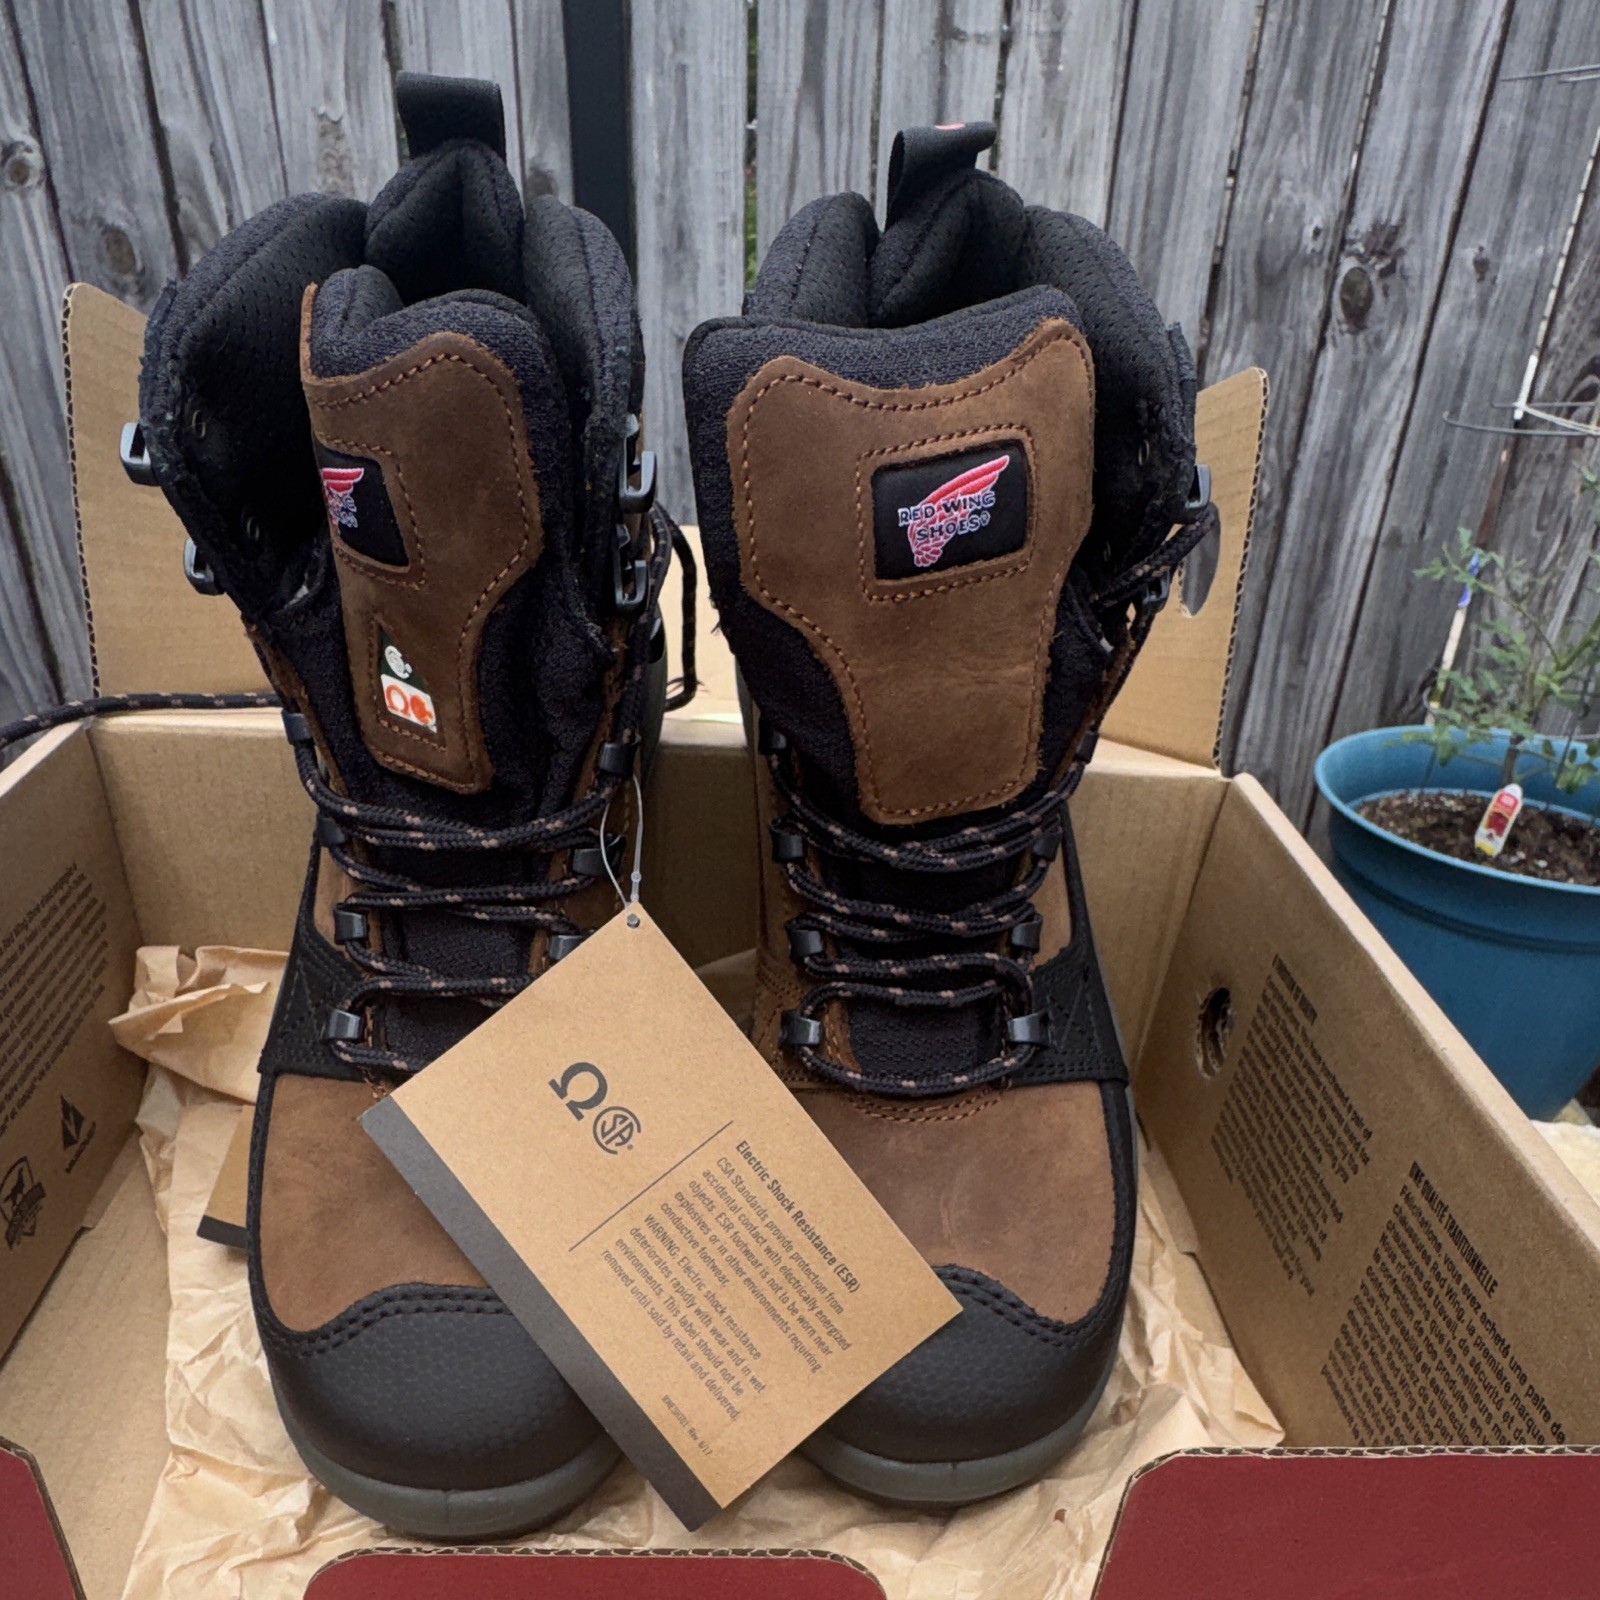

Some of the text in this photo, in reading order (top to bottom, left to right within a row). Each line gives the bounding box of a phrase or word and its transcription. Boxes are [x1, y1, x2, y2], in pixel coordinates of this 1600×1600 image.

[897, 490, 996, 528] RED WING
[641, 1213, 764, 1361] WARNING: Electric shock resistance
[657, 1200, 702, 1250] conductive
[670, 1189, 824, 1374] explosives or in other environments requiring
[699, 1167, 852, 1353] accidental contact with electrically energized
[713, 1212, 734, 1234] ESR
[727, 1230, 765, 1271] footwear
[757, 1266, 771, 1279] is
[764, 1275, 784, 1295] not
[777, 1290, 792, 1305] to
[785, 1300, 802, 1317] be
[794, 1313, 818, 1338] worn
[812, 1334, 834, 1357] near
[714, 1155, 846, 1315] CSA Standards provide protection from
[733, 1139, 862, 1295] Electric Shock Resistance (ESR)
[1408, 1159, 1499, 1299] UNE QUALITÉ TRADITIONNELLE
[598, 1248, 634, 1288] removed
[628, 1284, 652, 1310] until
[645, 1305, 667, 1329] sold
[659, 1323, 677, 1341] by
[669, 1335, 695, 1363] retail
[688, 1358, 710, 1381] and
[626, 1225, 767, 1394] deteriorates rapidly with wear and in wet
[660, 1295, 683, 1318] This
[676, 1313, 701, 1341] label
[693, 1336, 724, 1370] should
[717, 1365, 736, 1384] not
[729, 1380, 746, 1397] be
[1378, 1230, 1398, 1265] Nous
[1427, 1316, 1446, 1349] que
[1442, 1339, 1459, 1366] les
[1454, 1359, 1496, 1426] meilleurs
[1412, 1315, 1426, 1338] de
[1468, 1415, 1484, 1439] en
[1419, 1358, 1432, 1380] et
[1422, 1276, 1435, 1299] de
[1456, 1333, 1472, 1358] de
[1467, 1351, 1506, 1412] sécurité
[1500, 1407, 1517, 1430] et
[1429, 1259, 1447, 1290] Red
[1442, 1282, 1469, 1325] Wing,
[1465, 1318, 1477, 1337] la
[1472, 1331, 1514, 1397] première
[1508, 1390, 1546, 1446] marque
[1442, 1252, 1463, 1286] vous
[1460, 1281, 1481, 1315] avez
[1478, 1307, 1512, 1360] acheté
[1506, 1354, 1529, 1387] une
[1523, 1381, 1554, 1426] paire
[1548, 1418, 1569, 1446] de
[1395, 1372, 1418, 1412] Wing
[1417, 1382, 1431, 1405] de
[1426, 1399, 1438, 1419] la
[1433, 1414, 1454, 1446] part
